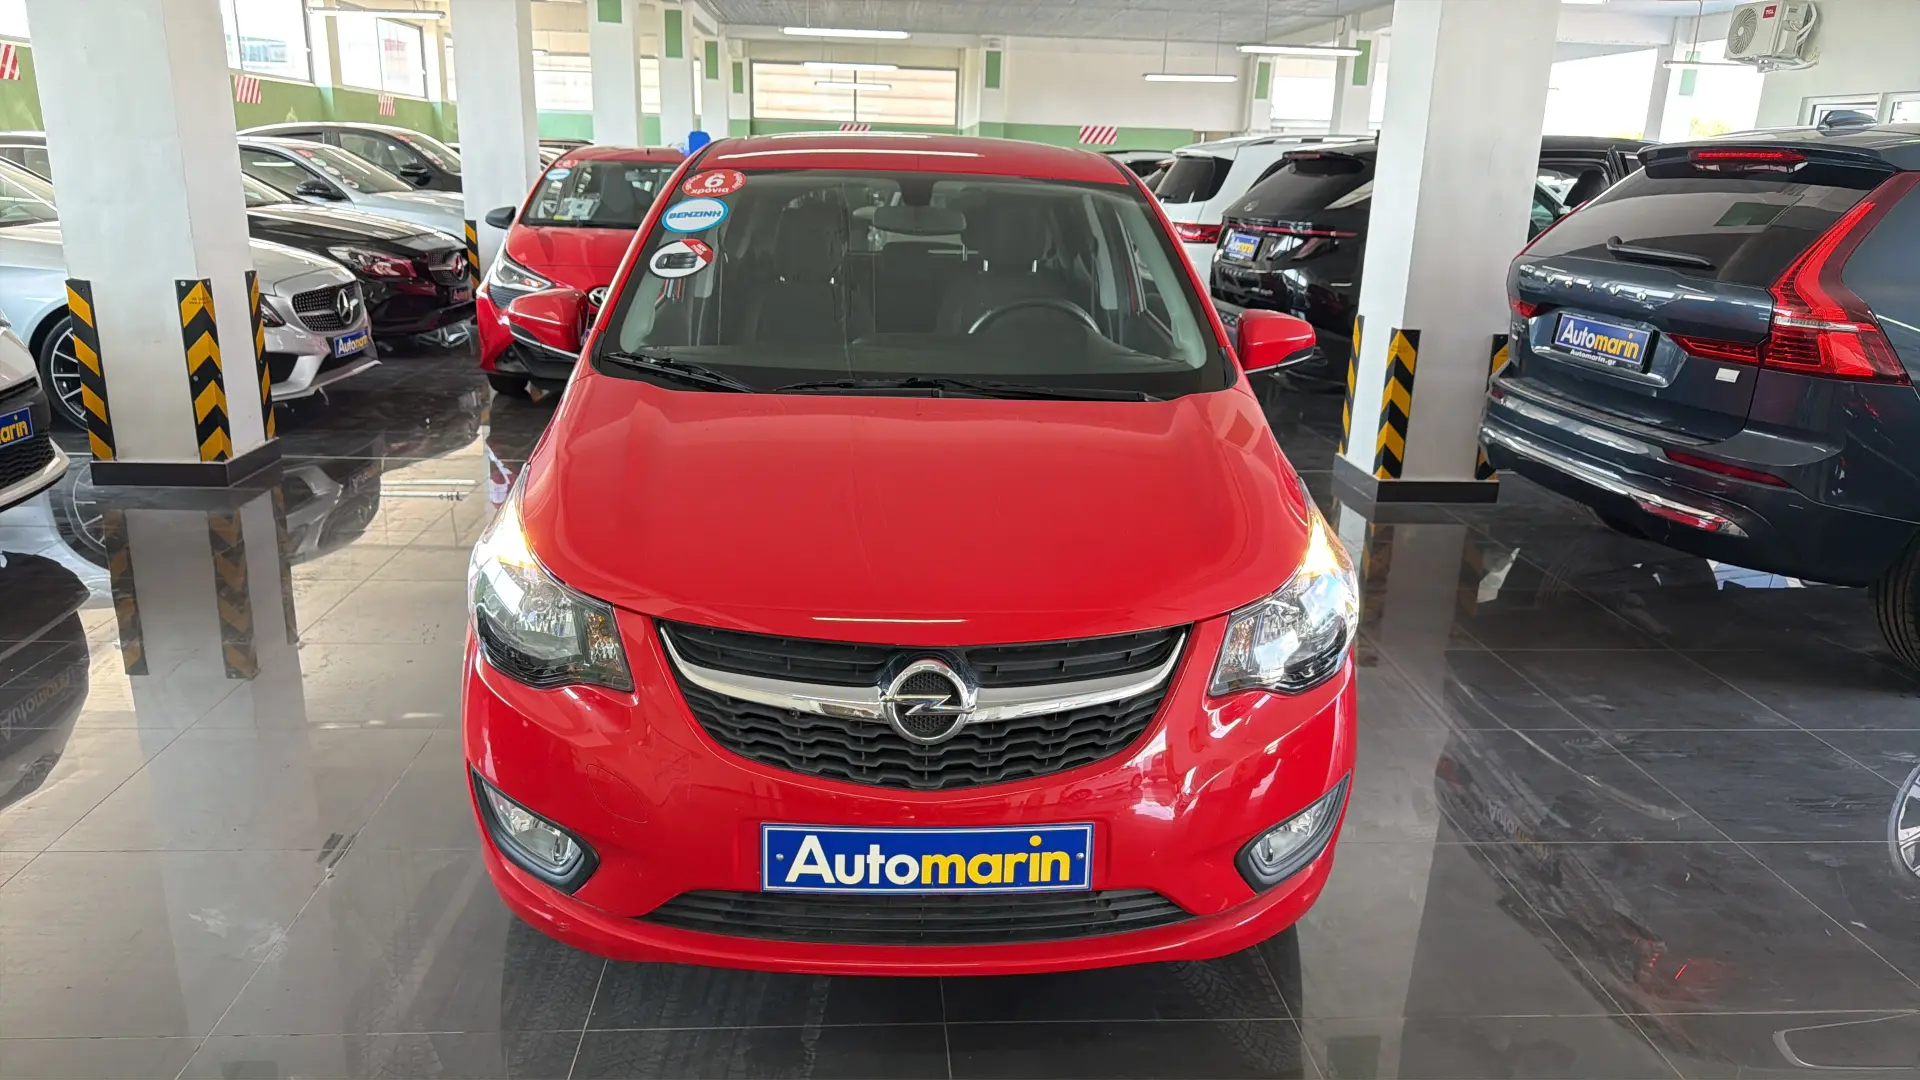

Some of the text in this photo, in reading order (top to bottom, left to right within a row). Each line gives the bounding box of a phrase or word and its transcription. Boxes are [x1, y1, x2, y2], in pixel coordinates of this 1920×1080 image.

[690, 187, 730, 195] χρόνια
[704, 174, 726, 188] 6
[1560, 320, 1640, 360] Automarin
[1569, 350, 1617, 366] Automarin.gr
[0, 414, 29, 444] arin
[784, 835, 1071, 885] Automarin
